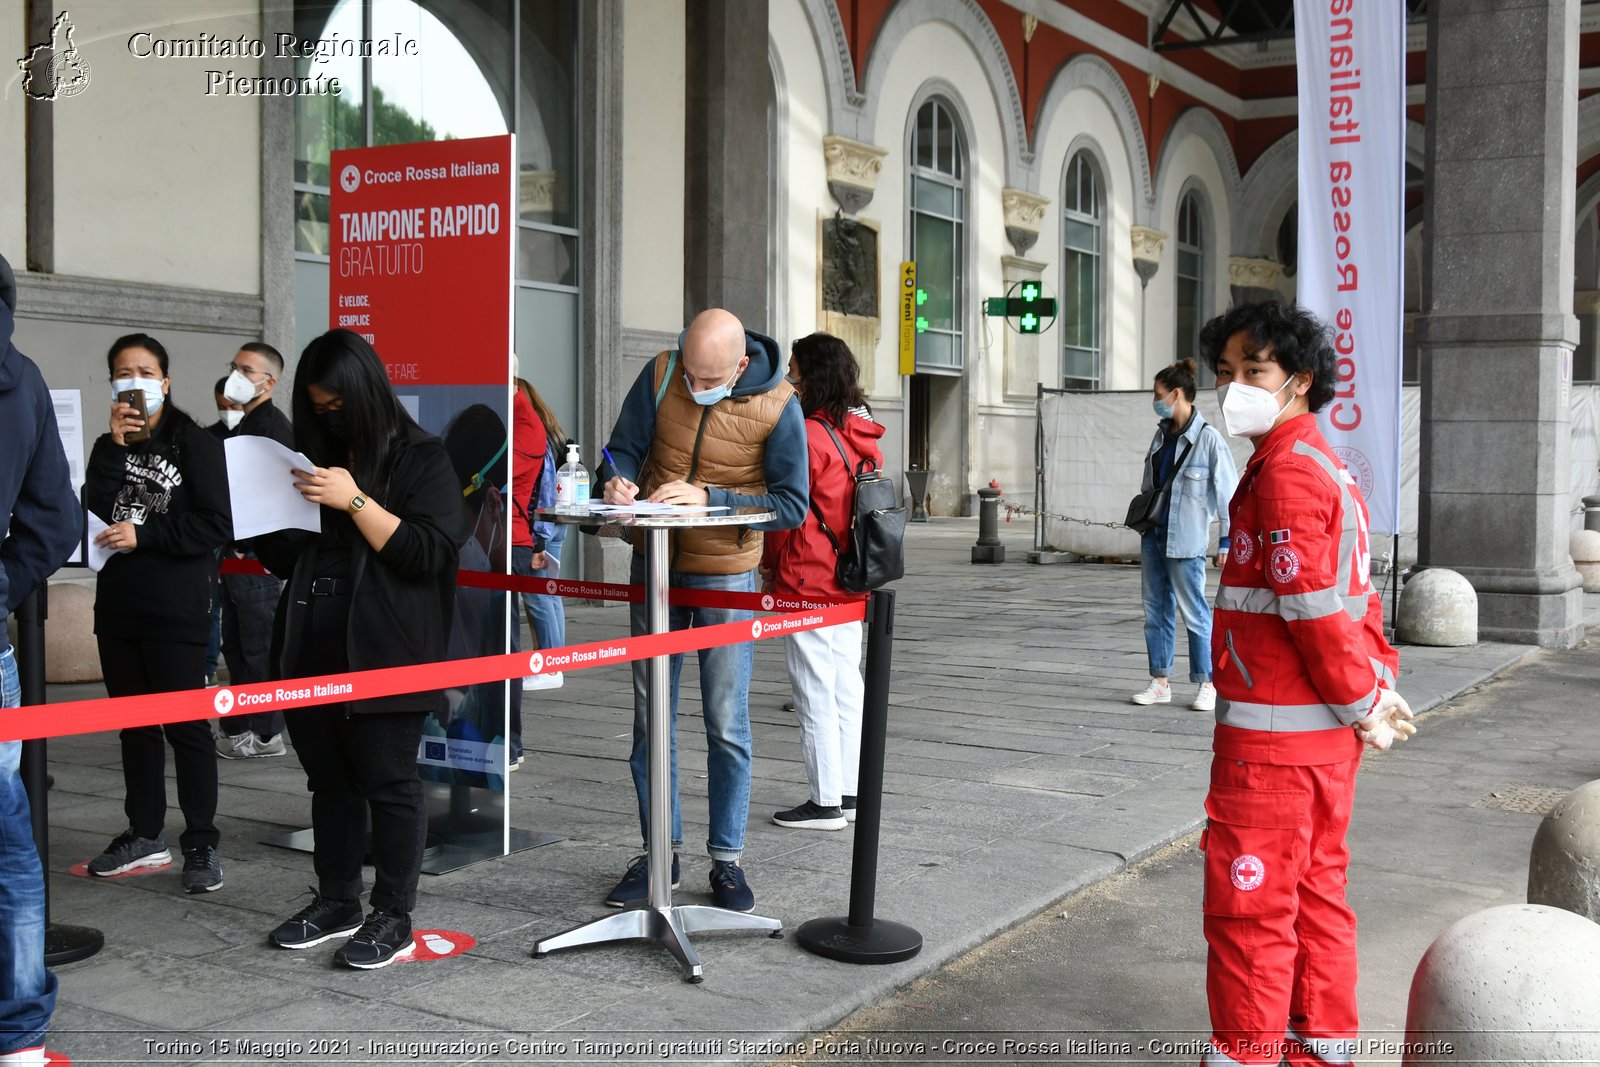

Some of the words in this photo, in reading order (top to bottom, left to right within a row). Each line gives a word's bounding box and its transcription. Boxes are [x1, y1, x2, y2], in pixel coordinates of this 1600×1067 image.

[364, 170, 402, 185] Croce
[406, 166, 447, 181] Rossa
[450, 161, 500, 178] Italiana
[340, 208, 425, 243] TAMPONE
[430, 203, 499, 238] RAPIDO
[340, 242, 424, 278] GRATUITO
[904, 291, 914, 321] Treni
[338, 314, 370, 326] SEMPLICE
[904, 324, 914, 351] Trains
[559, 584, 579, 593] Croce
[580, 586, 602, 595] Rossa
[603, 588, 629, 598] Italiana
[776, 599, 800, 608] Croce
[763, 622, 782, 632] Croce
[783, 619, 801, 629] Rossa
[802, 616, 824, 626] Italiana
[545, 655, 570, 666] Croce
[572, 651, 597, 663] Rossa
[598, 646, 627, 659] Italiana
[237, 692, 273, 706] Croce
[275, 688, 311, 702] Rossa
[313, 683, 353, 697] Italiana
